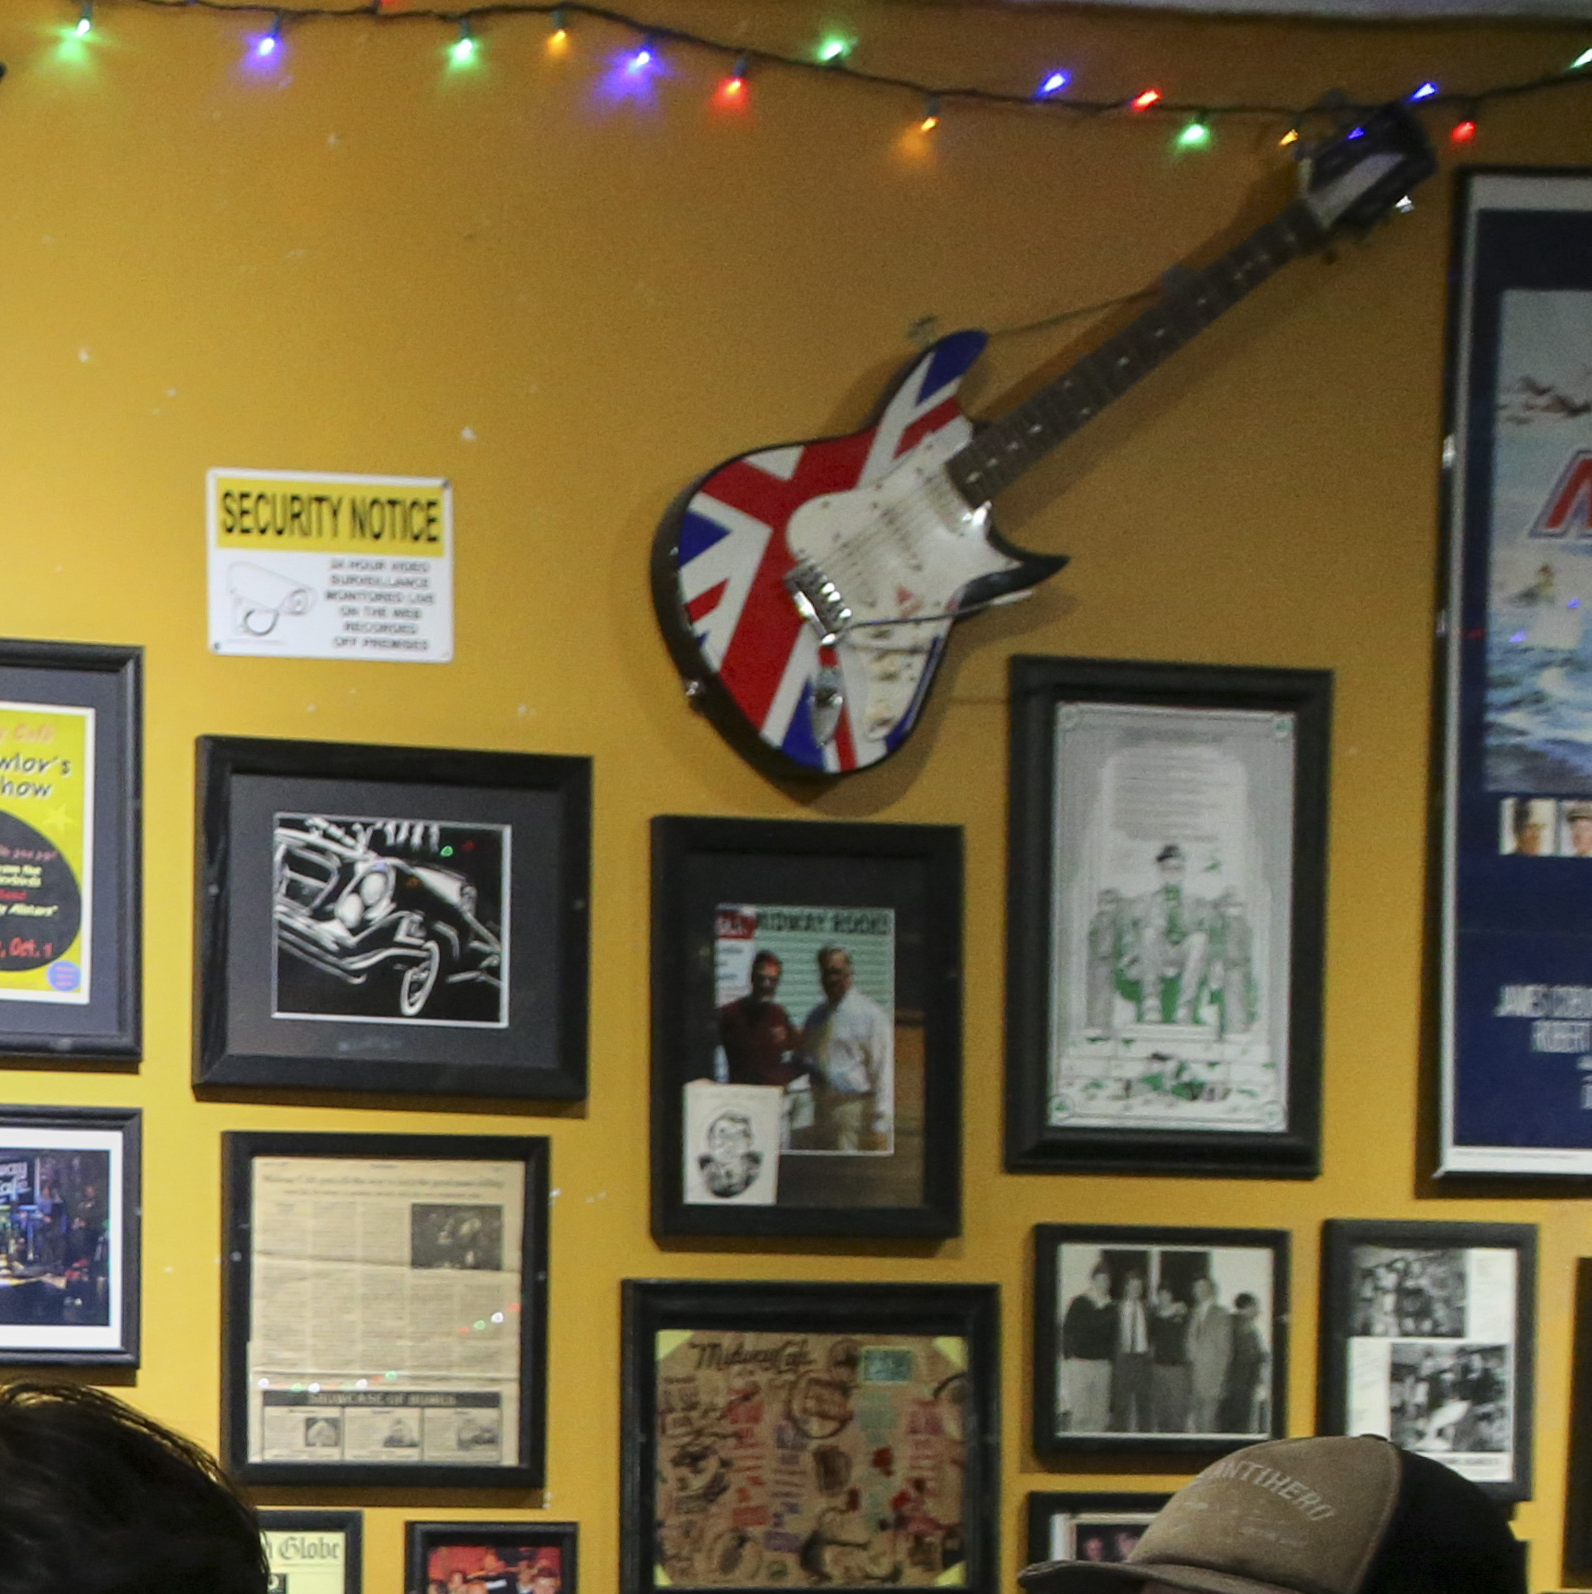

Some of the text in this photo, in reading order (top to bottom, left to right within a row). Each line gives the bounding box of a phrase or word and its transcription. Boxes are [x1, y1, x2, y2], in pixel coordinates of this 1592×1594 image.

[222, 489, 440, 543] SECURITY NOTICE
[349, 560, 387, 571] HOUR
[330, 575, 430, 589] SURVEILLANCE
[343, 622, 418, 635] RECORDED
[9, 936, 40, 958] Oct.
[43, 942, 54, 957] 1
[1213, 1459, 1336, 1522] ANTIHERO
[277, 1535, 341, 1561] Globe
